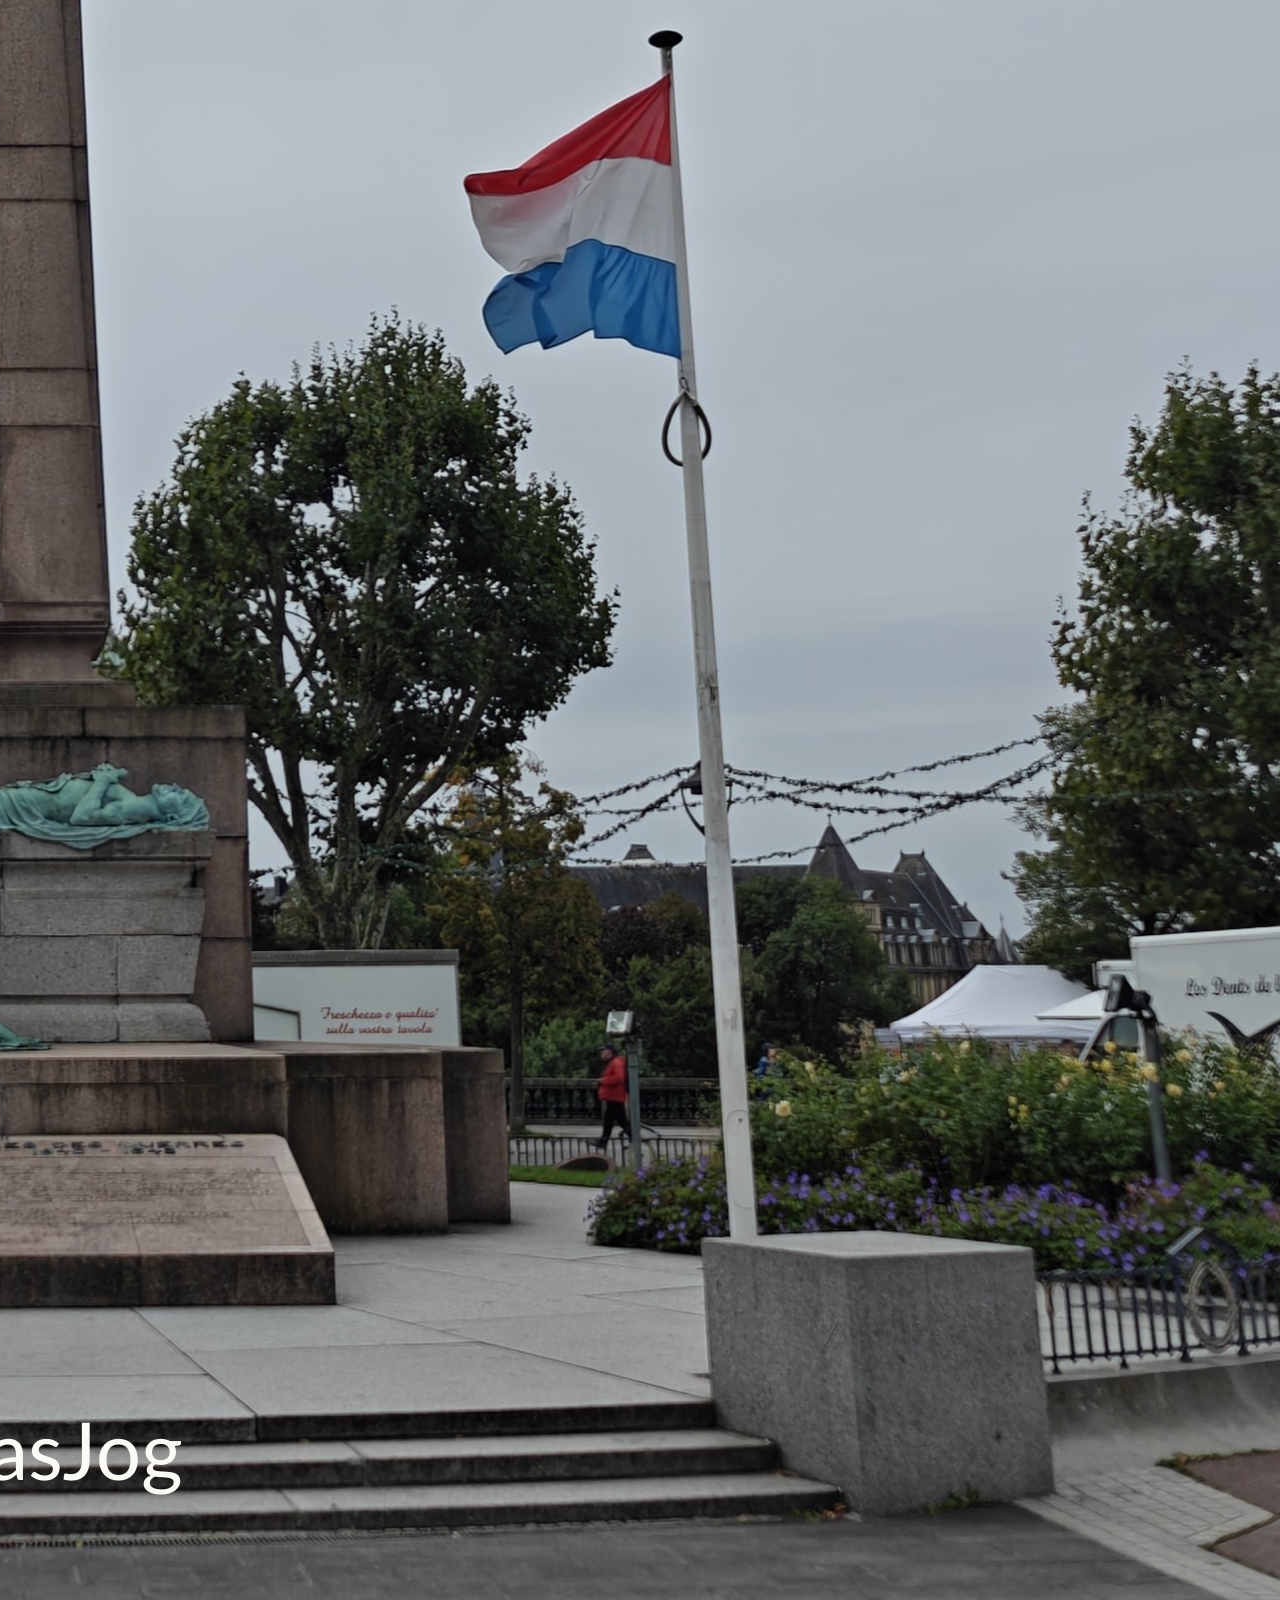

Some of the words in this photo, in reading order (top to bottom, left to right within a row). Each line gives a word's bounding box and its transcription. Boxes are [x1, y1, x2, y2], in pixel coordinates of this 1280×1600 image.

[325, 1022, 355, 1034] sulla
[358, 1024, 393, 1034] vostra
[397, 1022, 433, 1034] tavola
